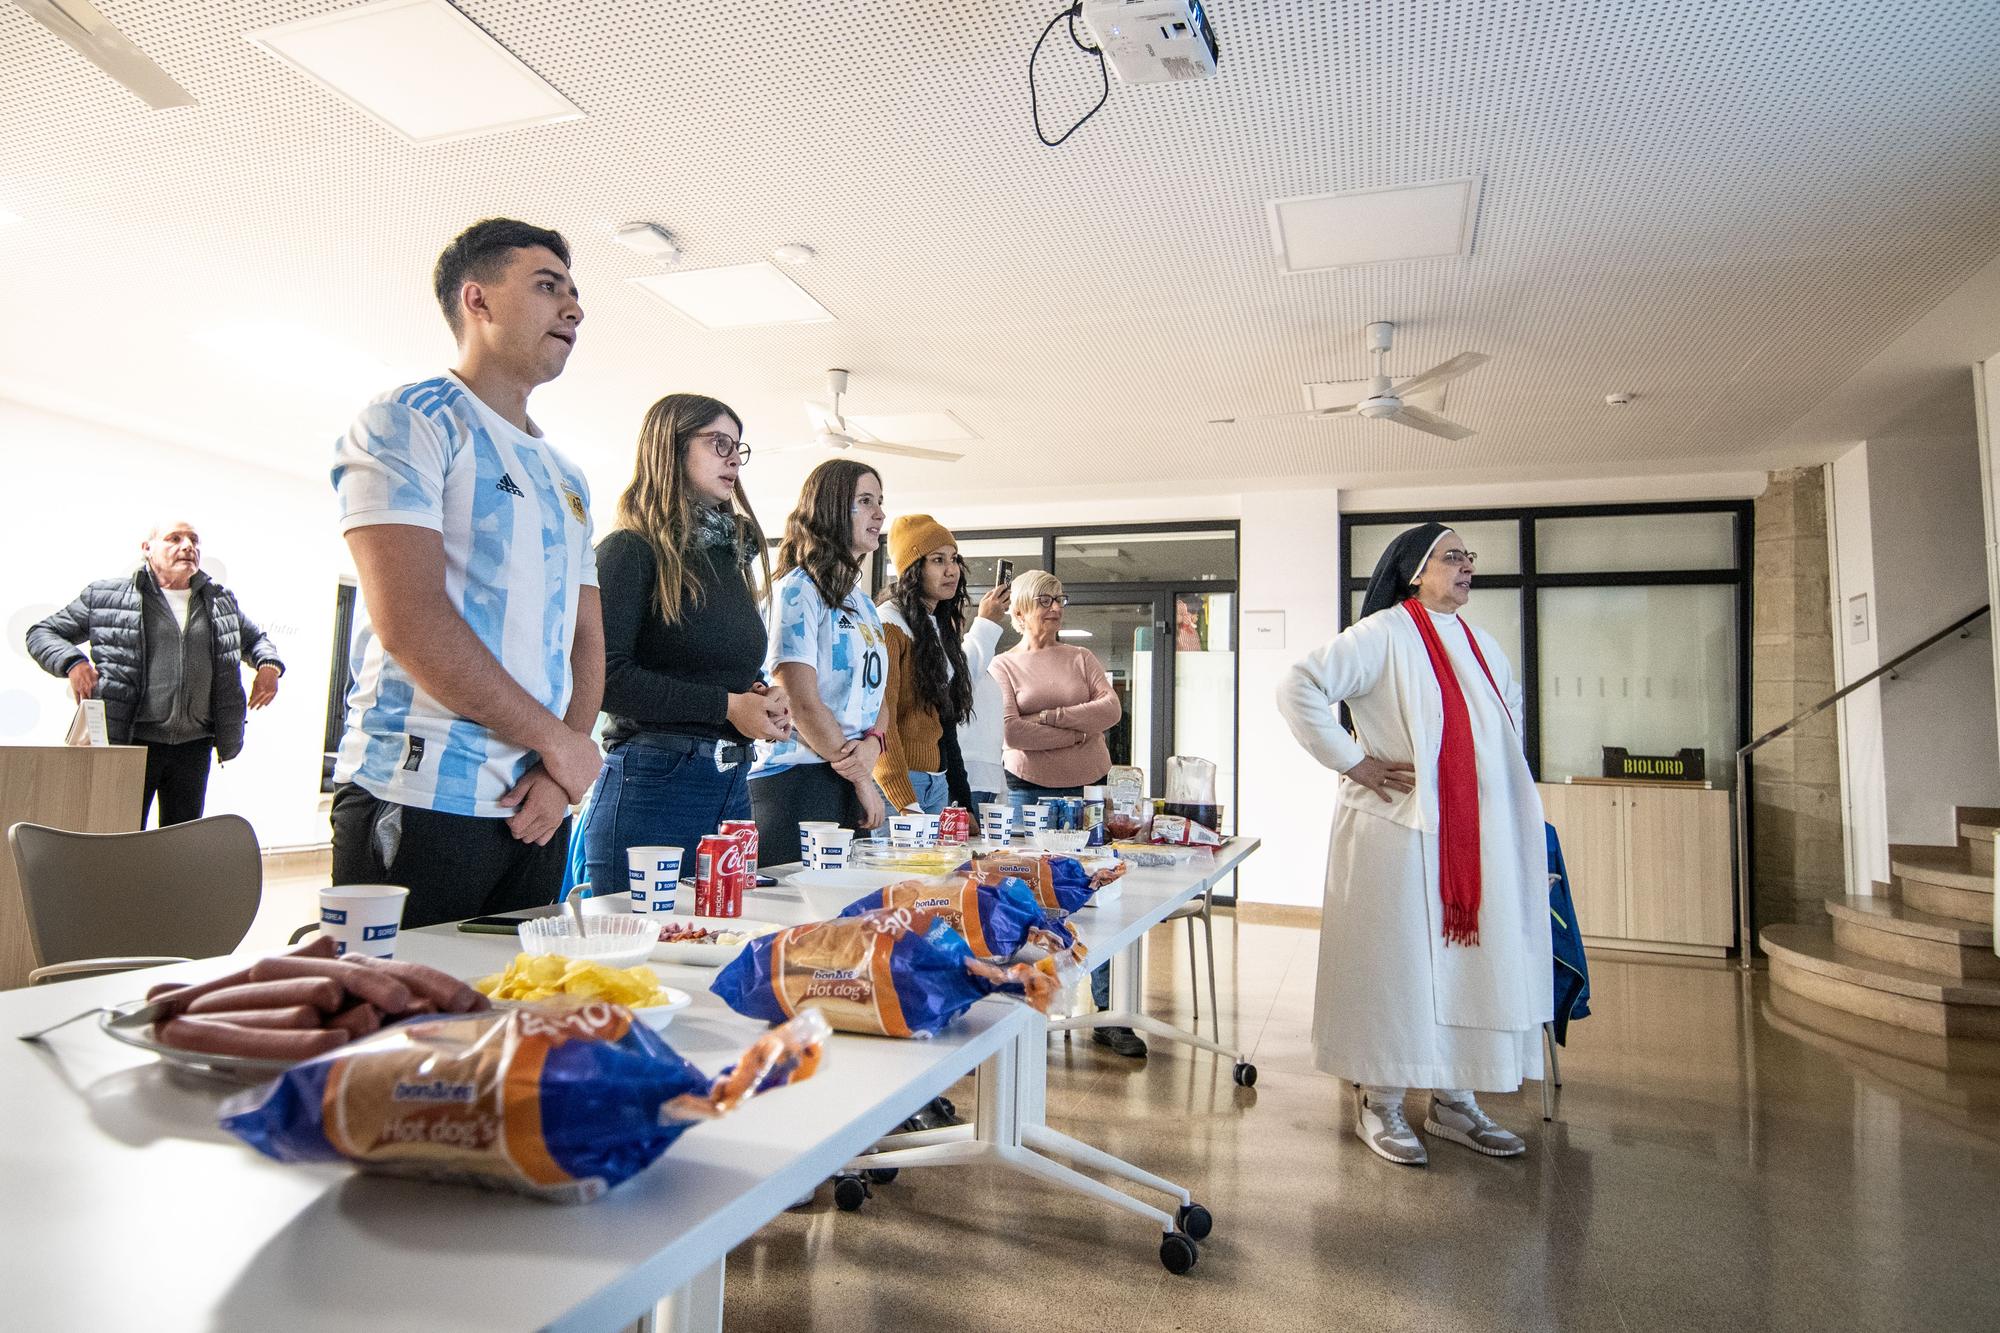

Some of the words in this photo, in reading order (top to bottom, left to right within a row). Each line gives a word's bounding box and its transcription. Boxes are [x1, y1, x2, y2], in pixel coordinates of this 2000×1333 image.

[496, 483, 525, 498] adidas
[861, 650, 882, 690] 10
[1623, 759, 1684, 775] BIOLORD
[814, 970, 857, 980] bonAre
[806, 982, 833, 996] Hot
[834, 981, 871, 1000] dog's
[383, 1119, 426, 1141] Hot
[430, 1114, 496, 1147] dog's
